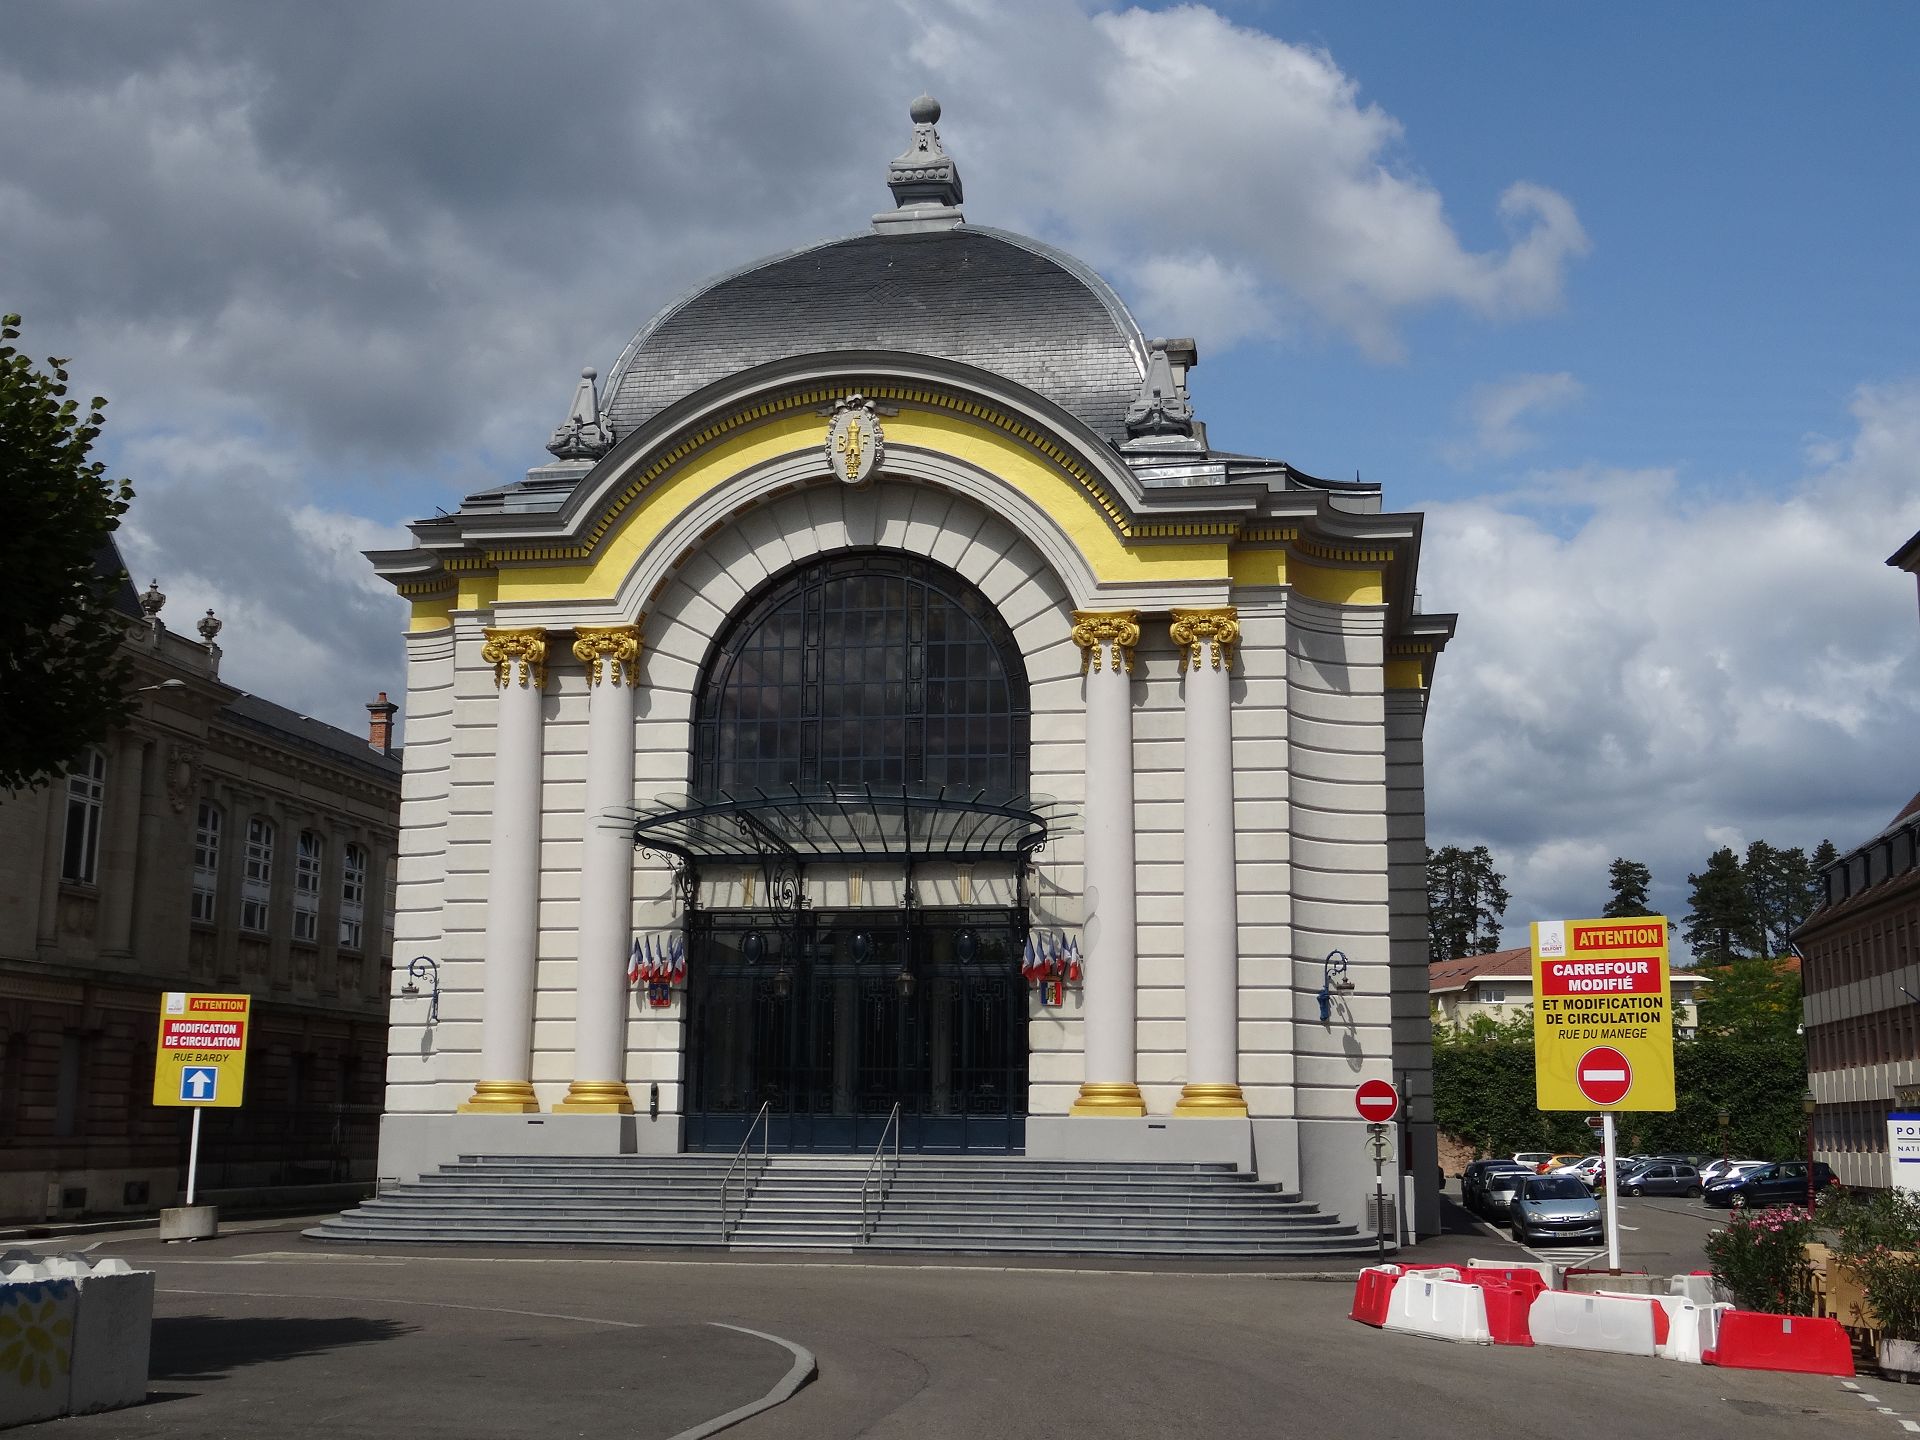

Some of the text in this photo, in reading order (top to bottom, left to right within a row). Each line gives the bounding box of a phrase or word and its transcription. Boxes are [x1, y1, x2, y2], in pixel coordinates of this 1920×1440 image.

[1579, 929, 1658, 946] ATTENTION
[1553, 962, 1648, 976] CARREFOUR
[1568, 976, 1633, 991] MODIFIÉ
[193, 1000, 243, 1010] ATTENTION
[1543, 997, 1663, 1010] ET MODIFICATION
[1546, 1012, 1661, 1024] DE CIRCULATION
[172, 1023, 236, 1034] MODIFICATION
[1558, 1029, 1647, 1039] RUE DU MANEGE
[165, 1036, 240, 1047] DE CIRCULATION
[173, 1053, 229, 1062] RUE BARDY
